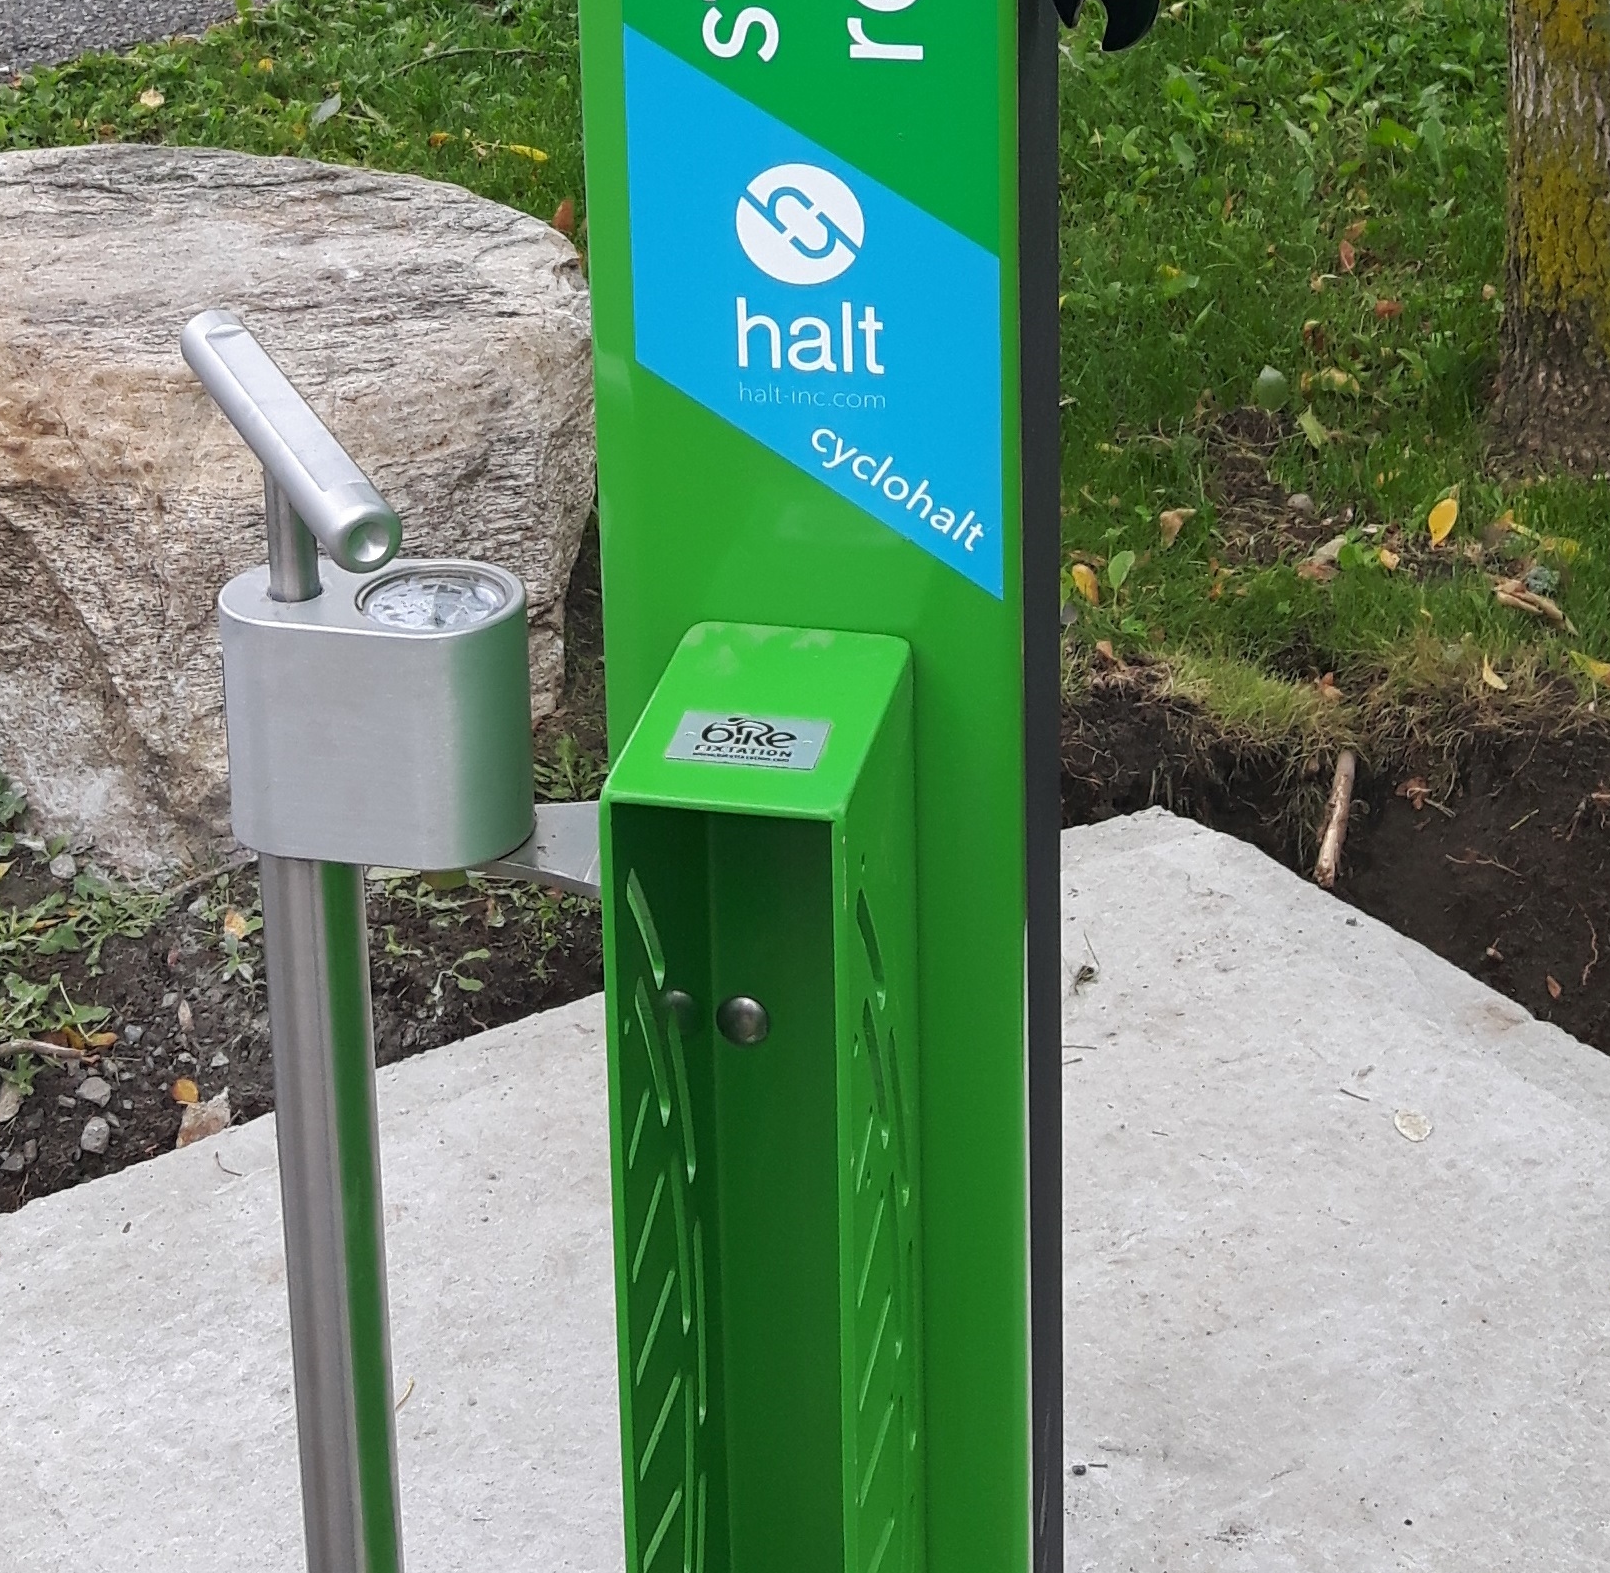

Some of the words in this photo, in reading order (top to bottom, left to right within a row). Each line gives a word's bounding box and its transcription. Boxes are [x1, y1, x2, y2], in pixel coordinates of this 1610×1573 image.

[736, 296, 885, 376] halt
[739, 381, 886, 409] halt-inc.com
[811, 428, 985, 552] cyclohalt
[694, 743, 793, 758] FIXTATION
